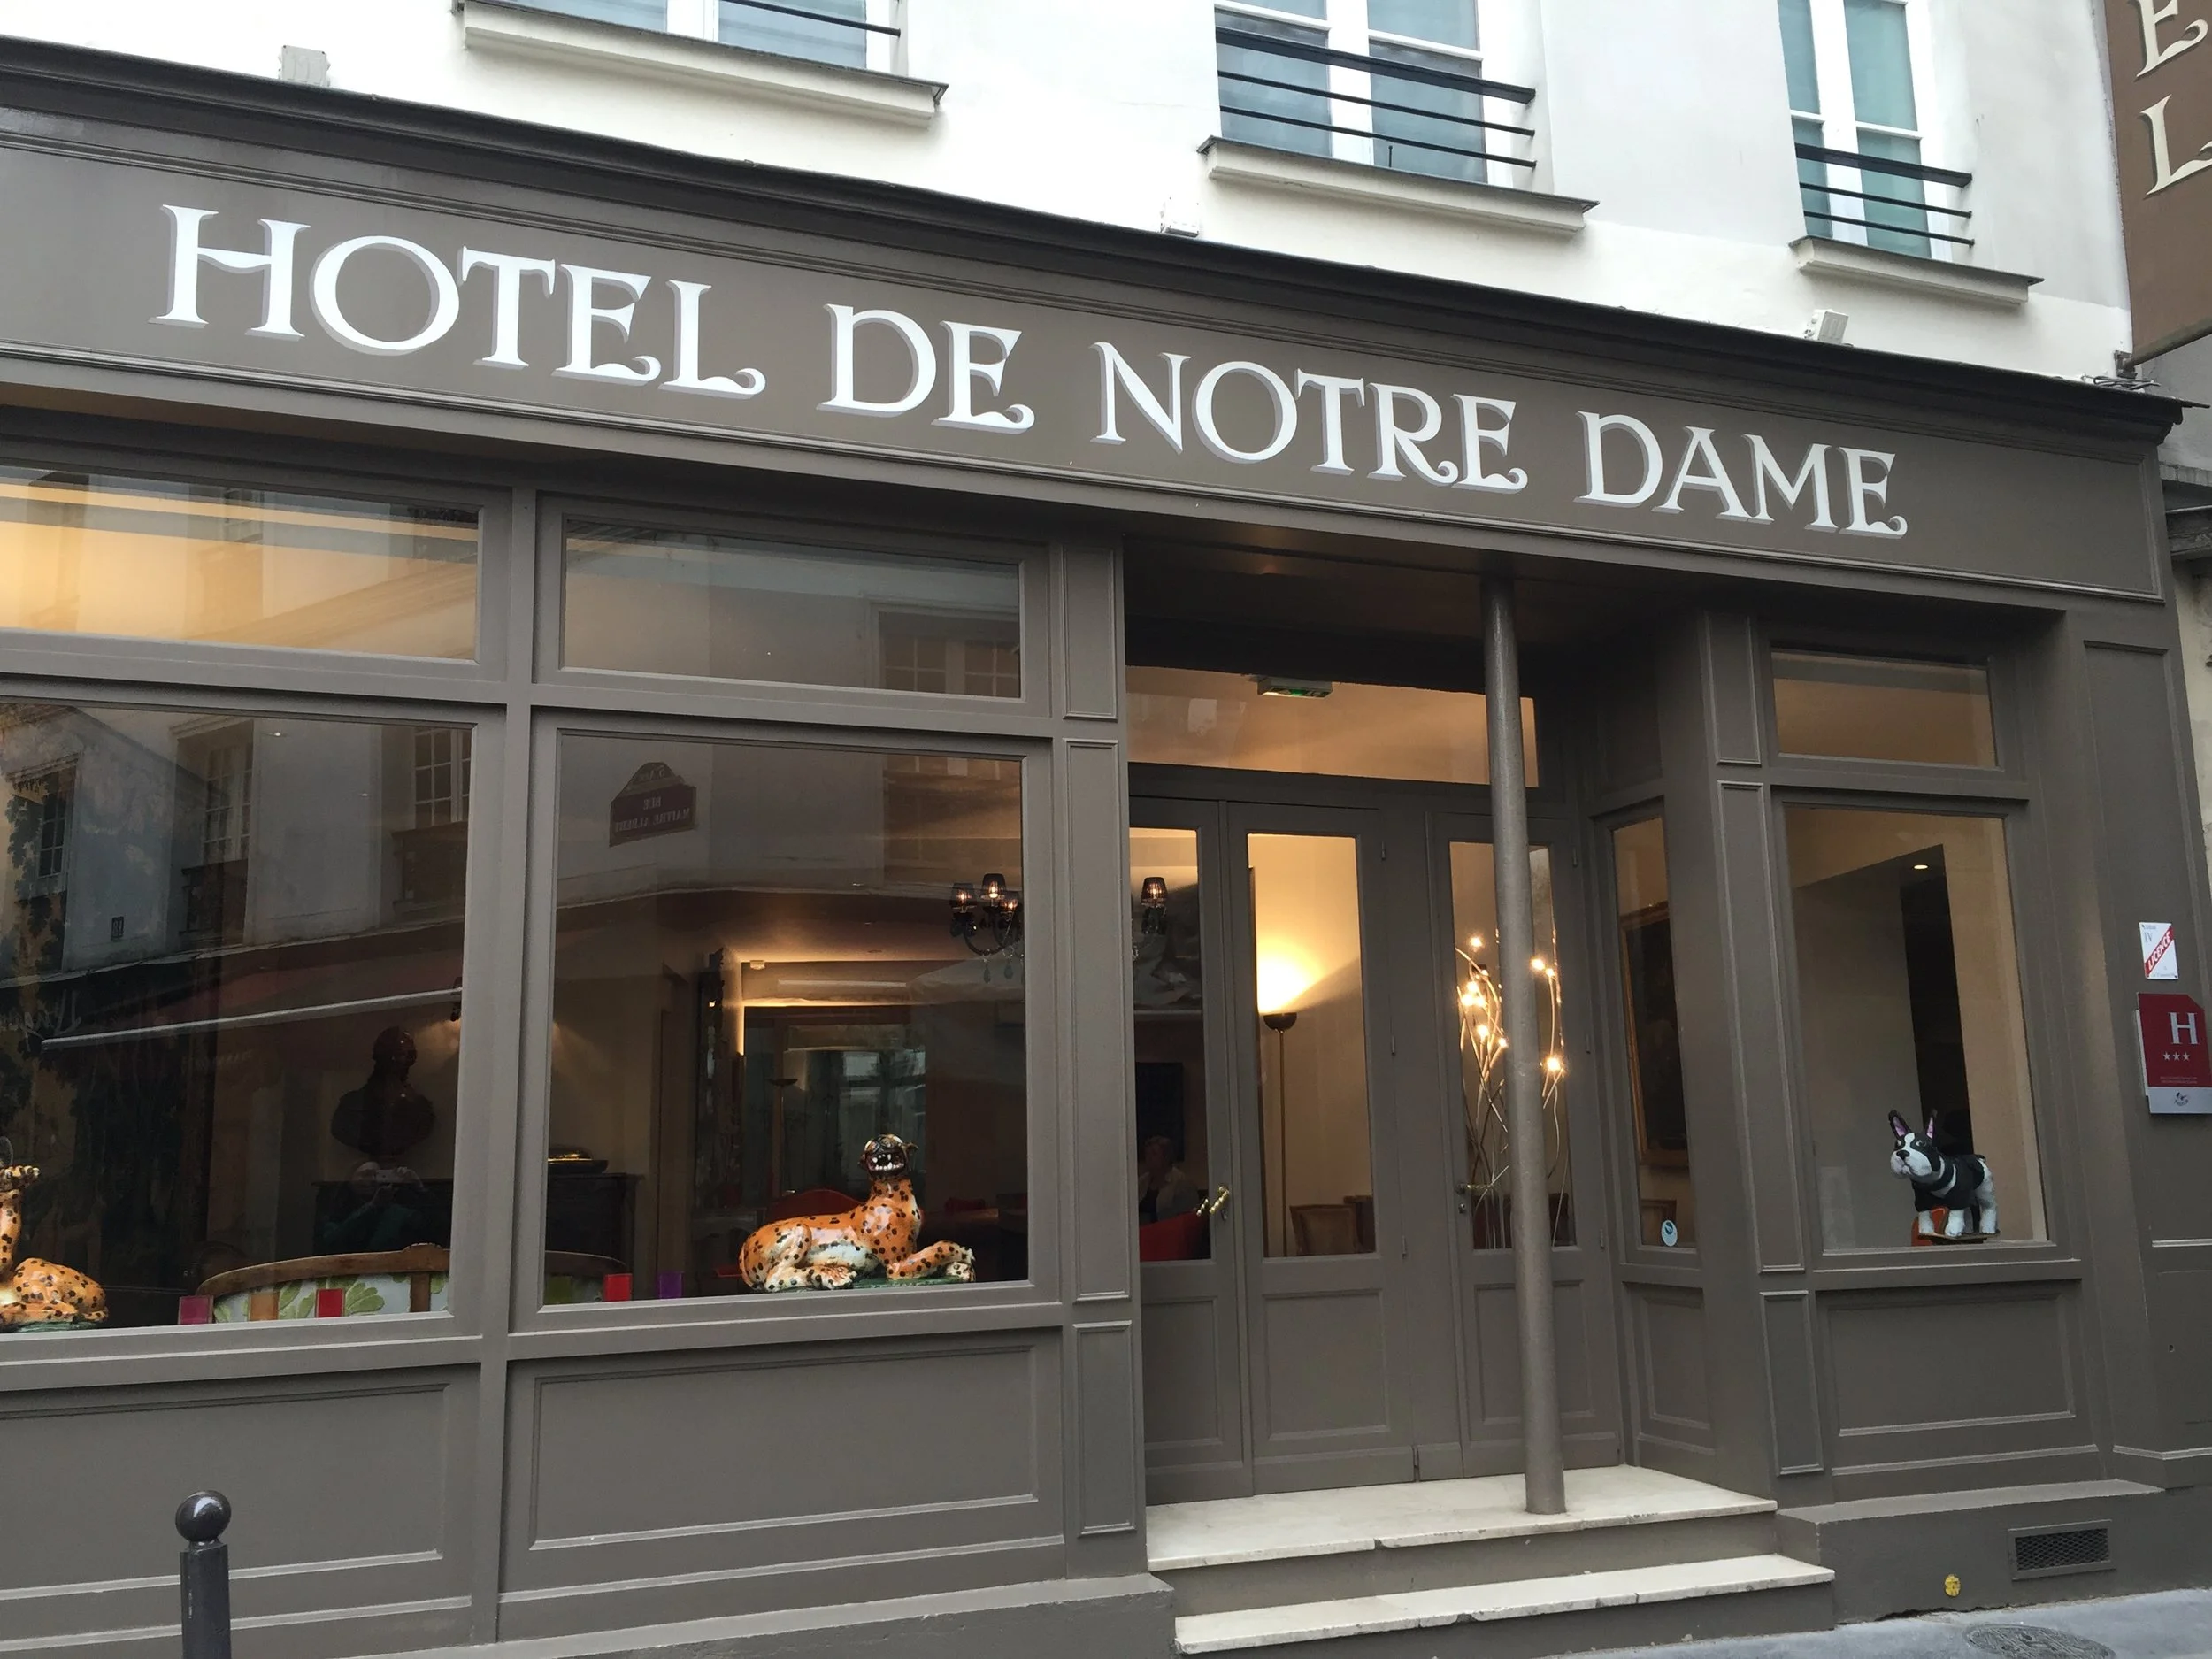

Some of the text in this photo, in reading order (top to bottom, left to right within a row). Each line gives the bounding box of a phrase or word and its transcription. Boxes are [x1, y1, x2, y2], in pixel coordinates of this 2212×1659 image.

[151, 204, 1908, 539] HOTEL DE NOTRE DAME
[2147, 931, 2171, 971] LICENCE
[2167, 1011, 2200, 1044] H
